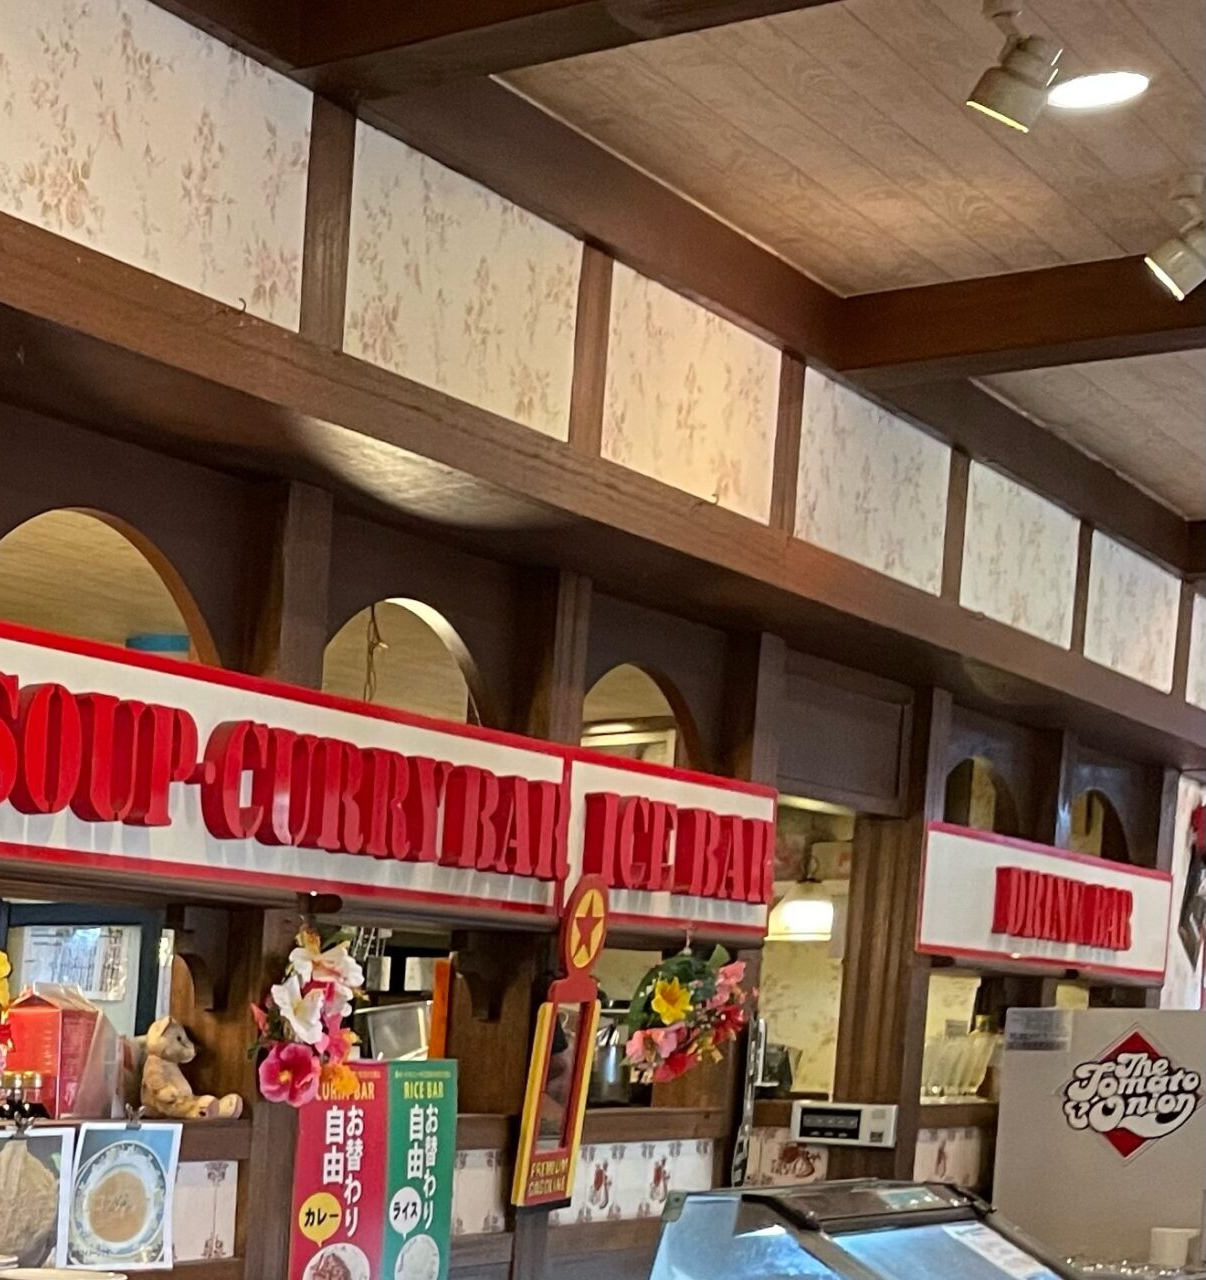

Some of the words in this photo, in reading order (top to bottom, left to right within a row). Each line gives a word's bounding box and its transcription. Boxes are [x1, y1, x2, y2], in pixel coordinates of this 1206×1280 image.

[438, 765, 571, 882] BAR
[582, 792, 678, 890] ICE
[672, 807, 775, 904] BAR
[991, 867, 1087, 944] DRINK
[1081, 884, 1134, 951] BAR
[403, 1081, 424, 1099] RICE
[427, 1080, 444, 1099] BAR
[1065, 1061, 1201, 1101] Tomato
[1114, 1052, 1170, 1079] The
[322, 1105, 345, 1185] 自由
[407, 1103, 424, 1180] 自由
[1089, 1093, 1197, 1139] Onion
[343, 1104, 364, 1238] お替わり
[422, 1103, 439, 1230] お替わり
[303, 1207, 339, 1228] カレー
[393, 1201, 418, 1222] ライス
